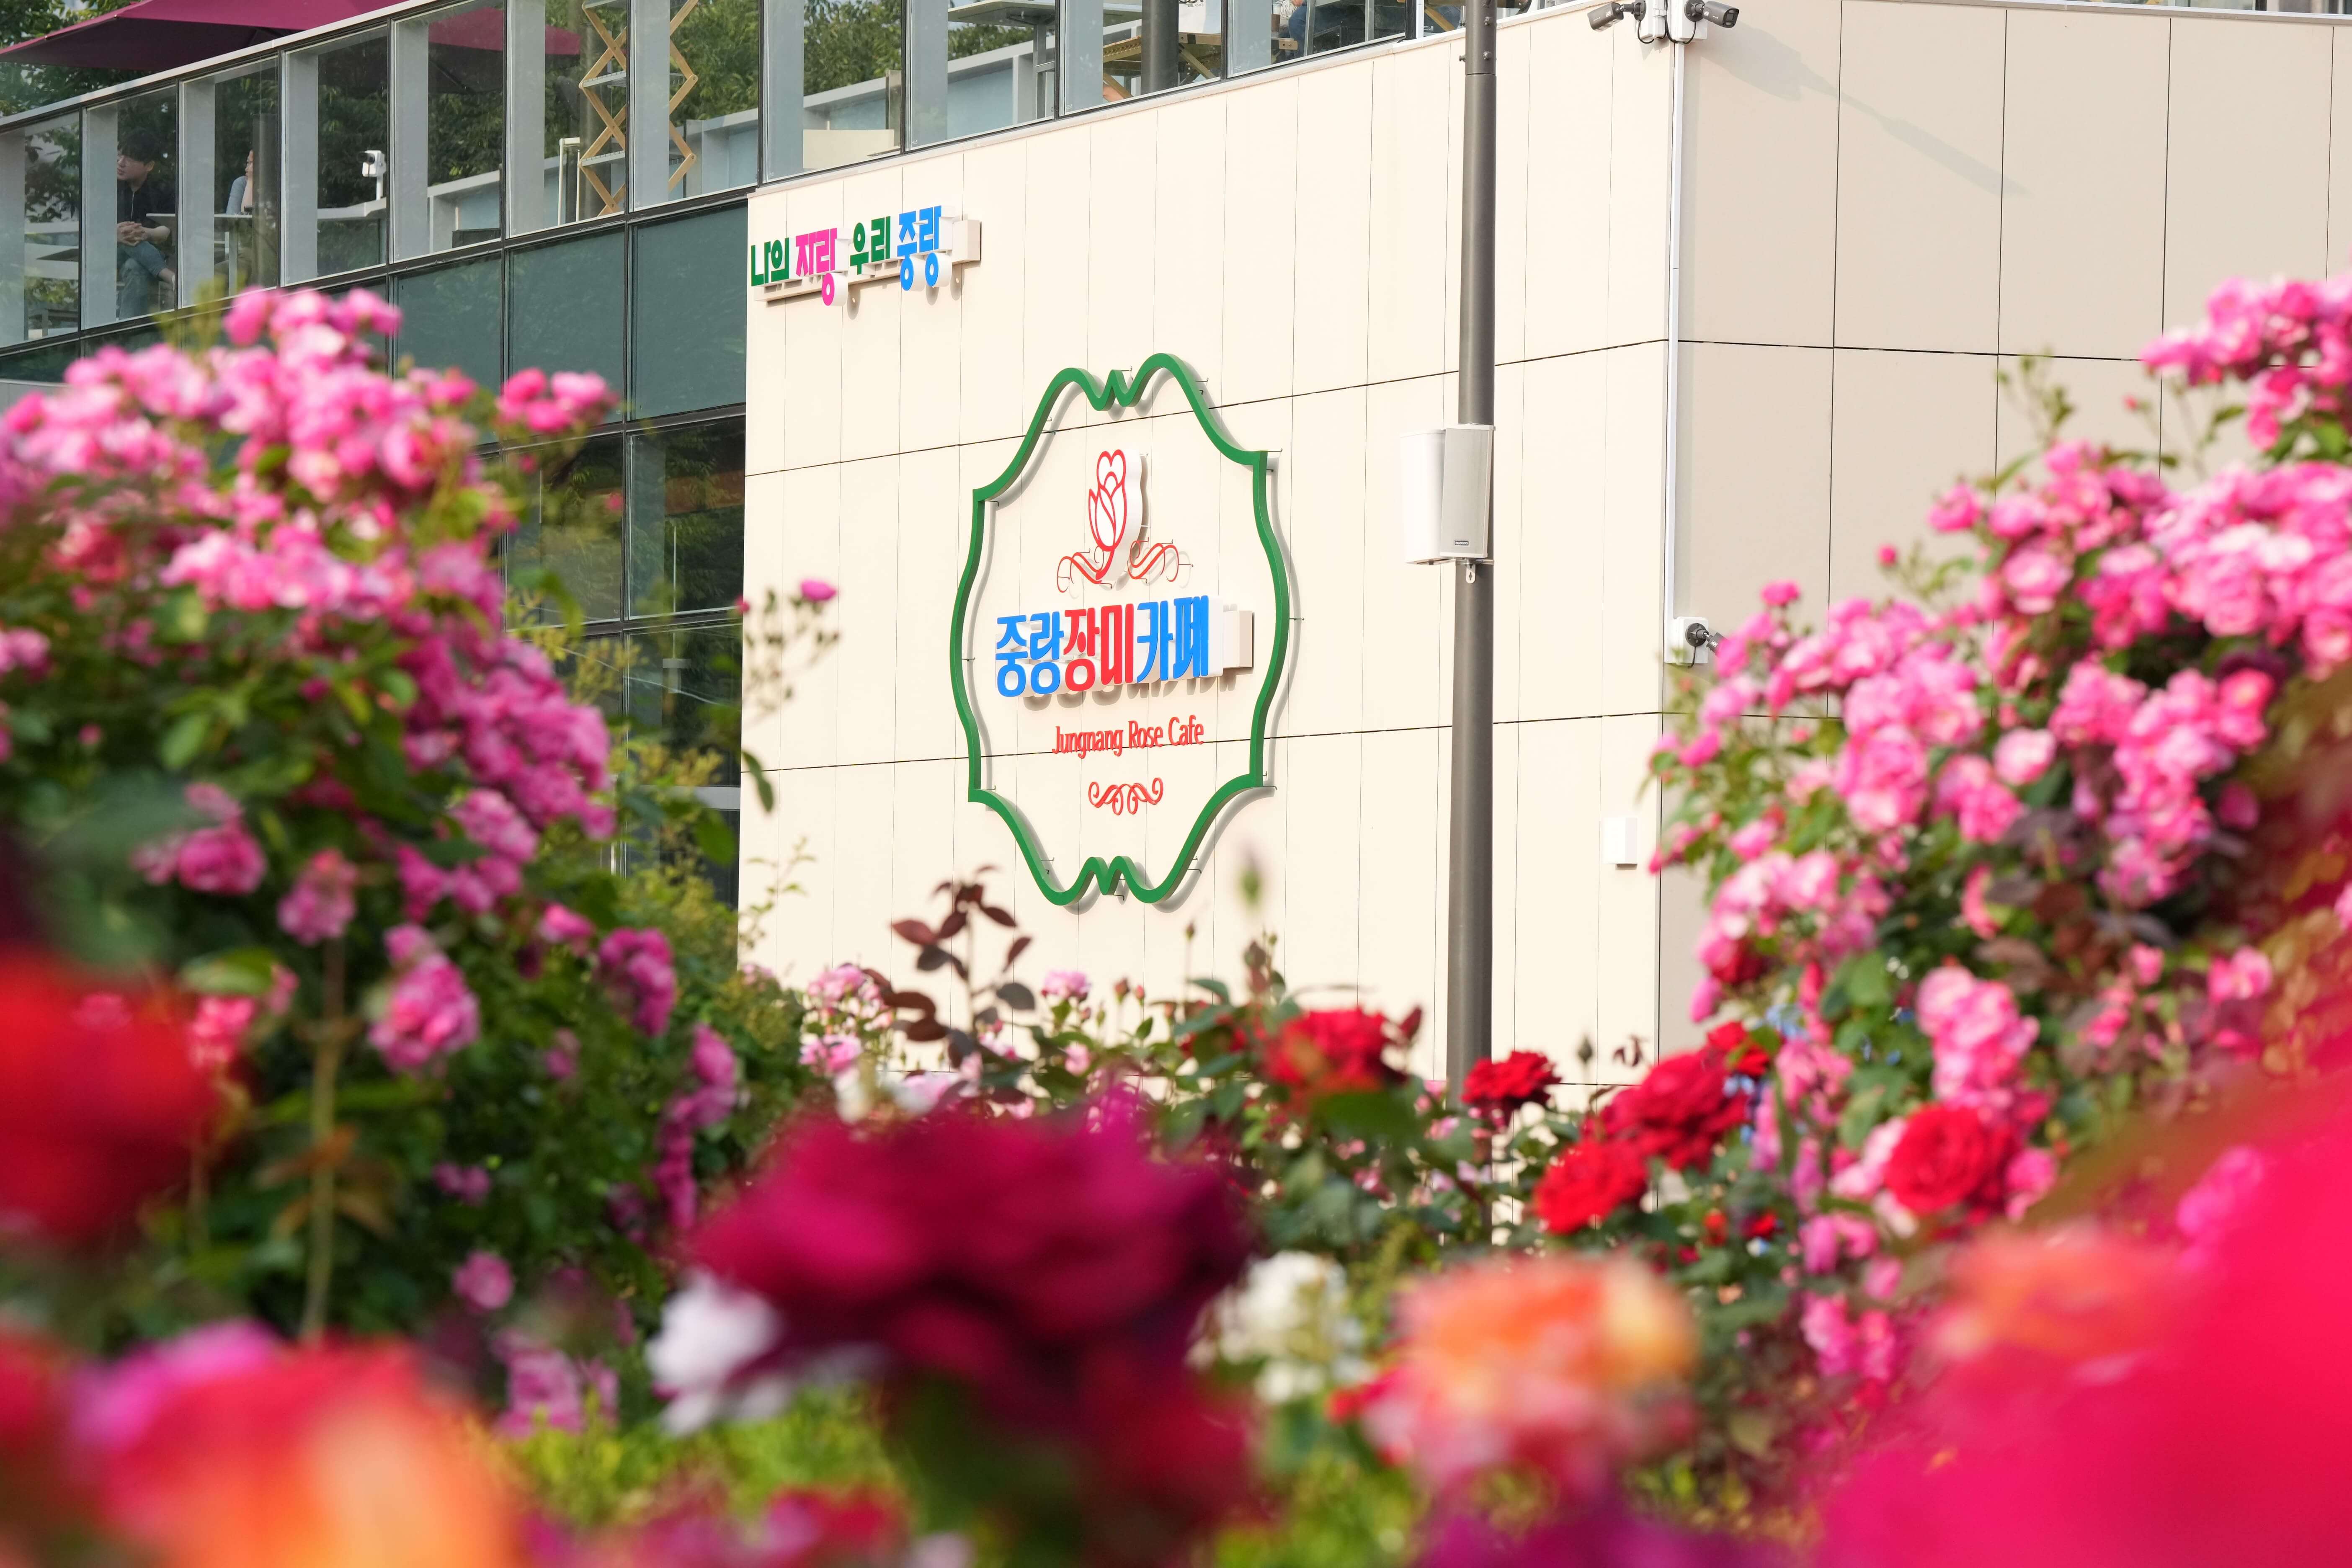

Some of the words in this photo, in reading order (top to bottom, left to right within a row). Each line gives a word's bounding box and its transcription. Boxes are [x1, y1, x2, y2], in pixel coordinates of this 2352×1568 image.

[751, 237, 789, 286] 나의
[796, 227, 838, 306] 자랑
[850, 216, 891, 275] 우리
[897, 205, 942, 291] 중랑
[995, 595, 1209, 697] 중랑장미카페
[1052, 726, 1123, 758] Jungnang
[1128, 720, 1163, 748] Rose
[1168, 715, 1204, 746] Cafe
